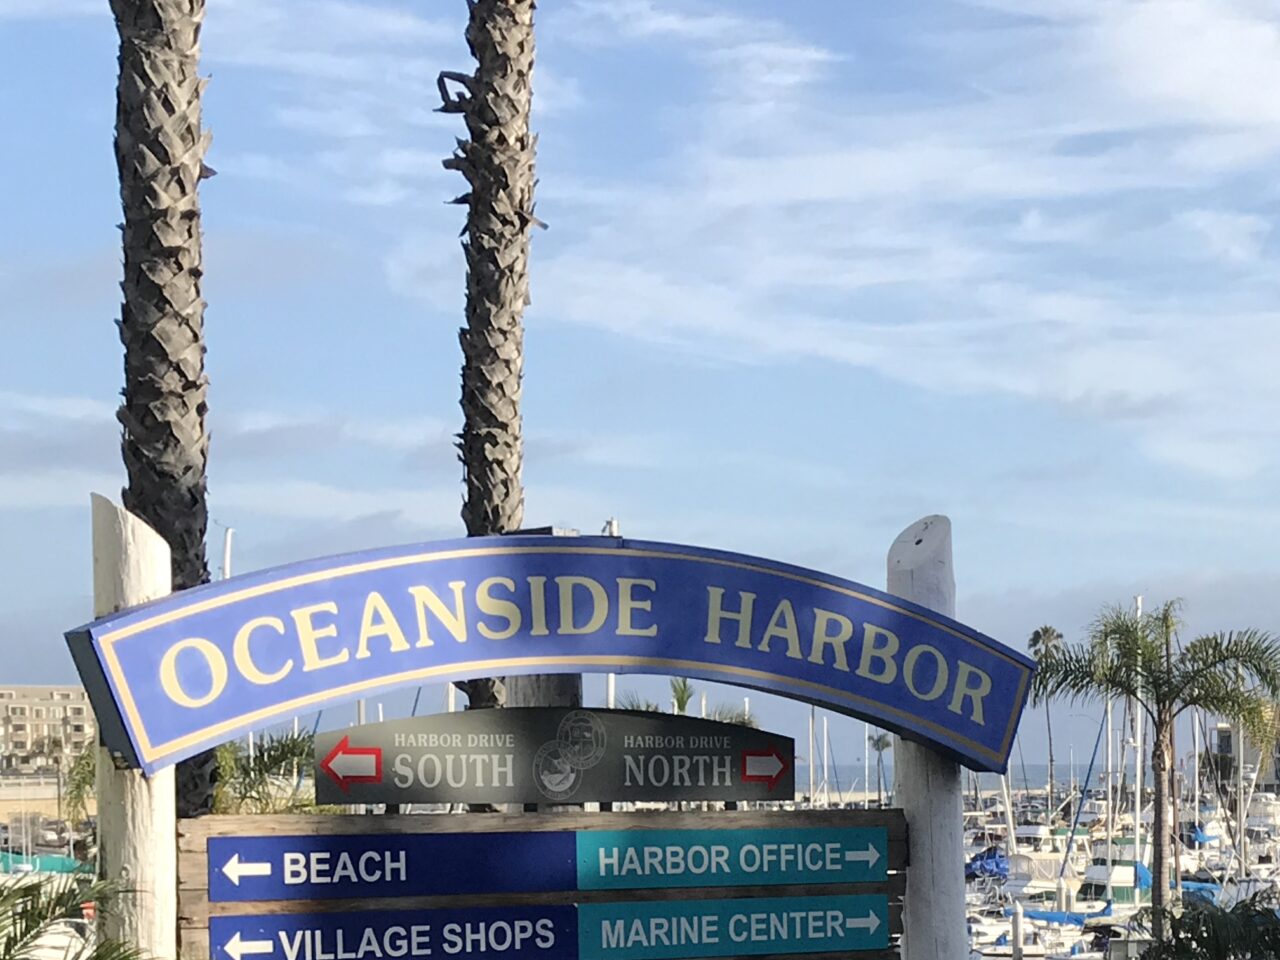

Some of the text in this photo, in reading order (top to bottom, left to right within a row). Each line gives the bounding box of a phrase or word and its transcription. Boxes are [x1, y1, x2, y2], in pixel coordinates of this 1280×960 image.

[159, 577, 993, 726] OCEANSIDE HARBOR
[394, 733, 514, 748] HARBOR DRIVE
[624, 735, 731, 750] HARBOR DRIVE
[394, 754, 514, 788] SOUTH
[624, 754, 732, 787] NORTH
[283, 850, 407, 885] BEACH
[598, 843, 842, 876] HARBOR OFFICE
[441, 918, 555, 954] SHOPS
[601, 910, 844, 948] MARINE CENTER
